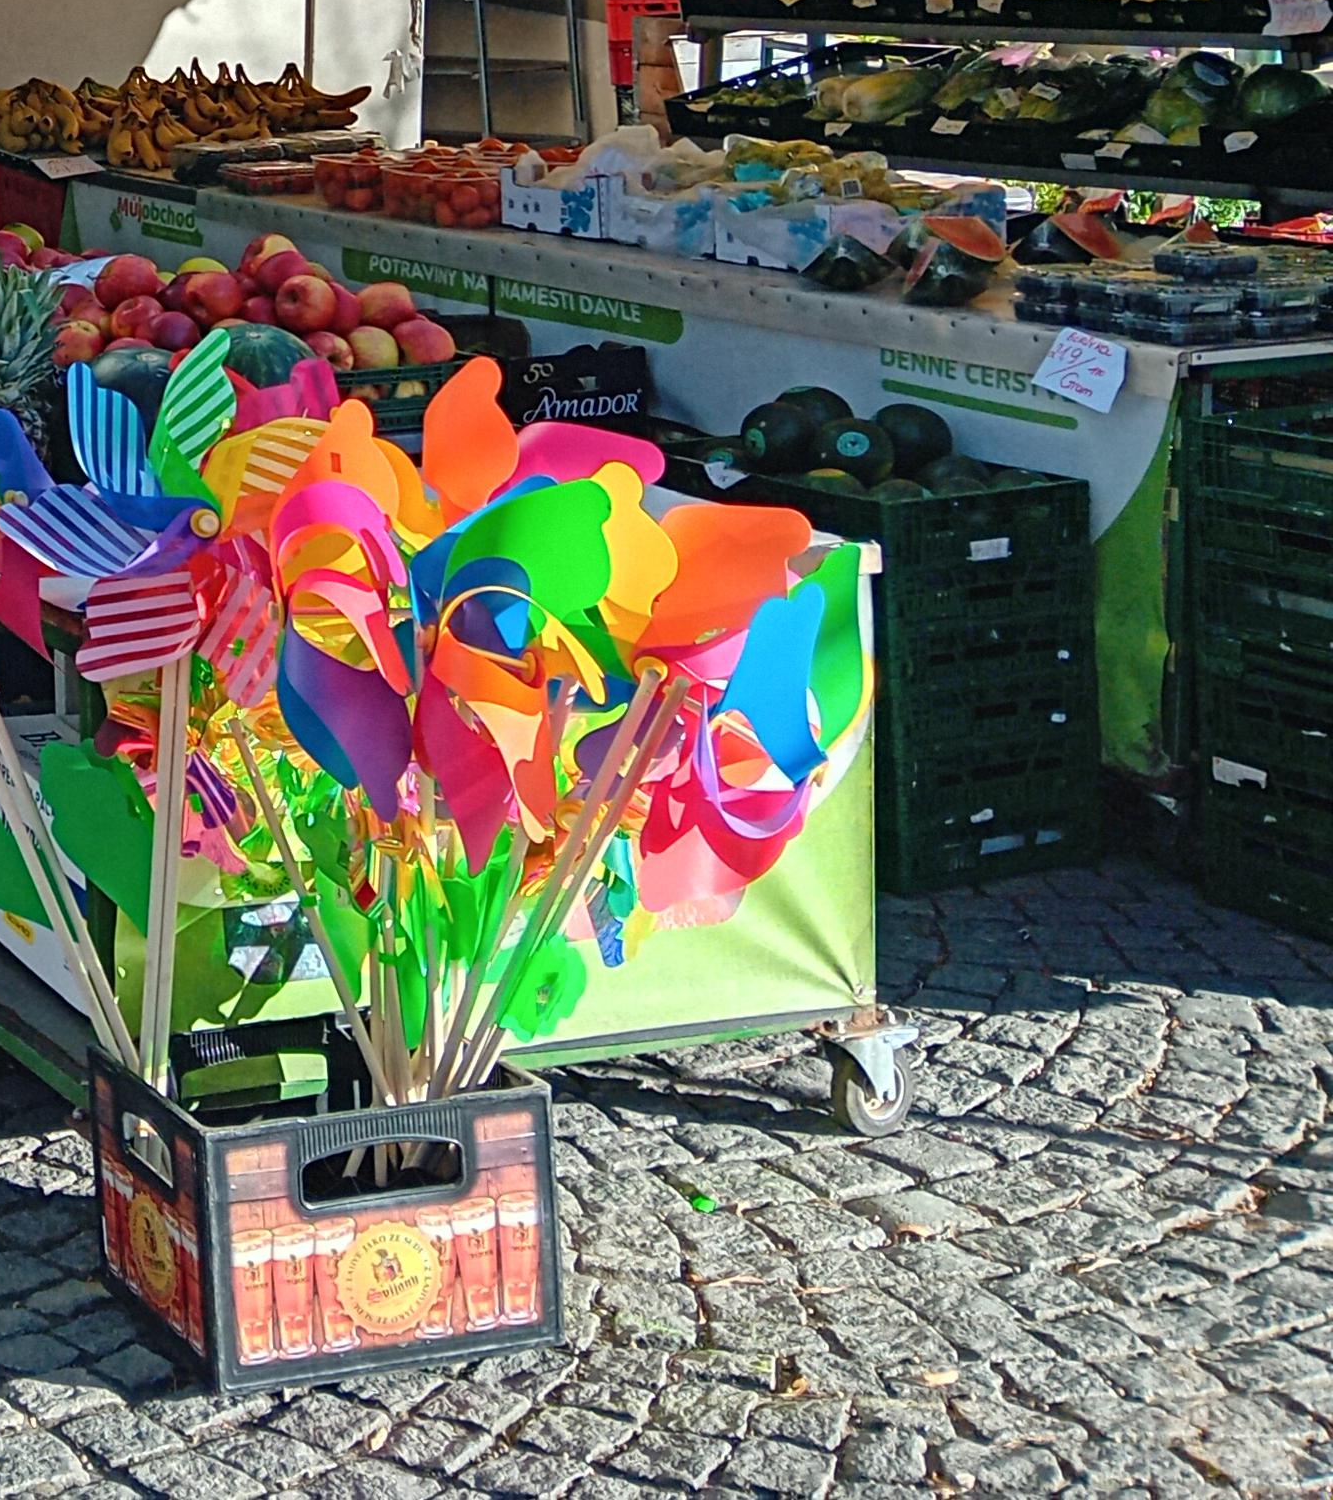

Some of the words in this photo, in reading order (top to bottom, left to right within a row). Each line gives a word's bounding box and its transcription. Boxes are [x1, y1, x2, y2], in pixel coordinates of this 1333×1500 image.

[368, 254, 458, 288] POTRAVINY
[463, 272, 489, 292] NA
[579, 294, 643, 324] DAVLE
